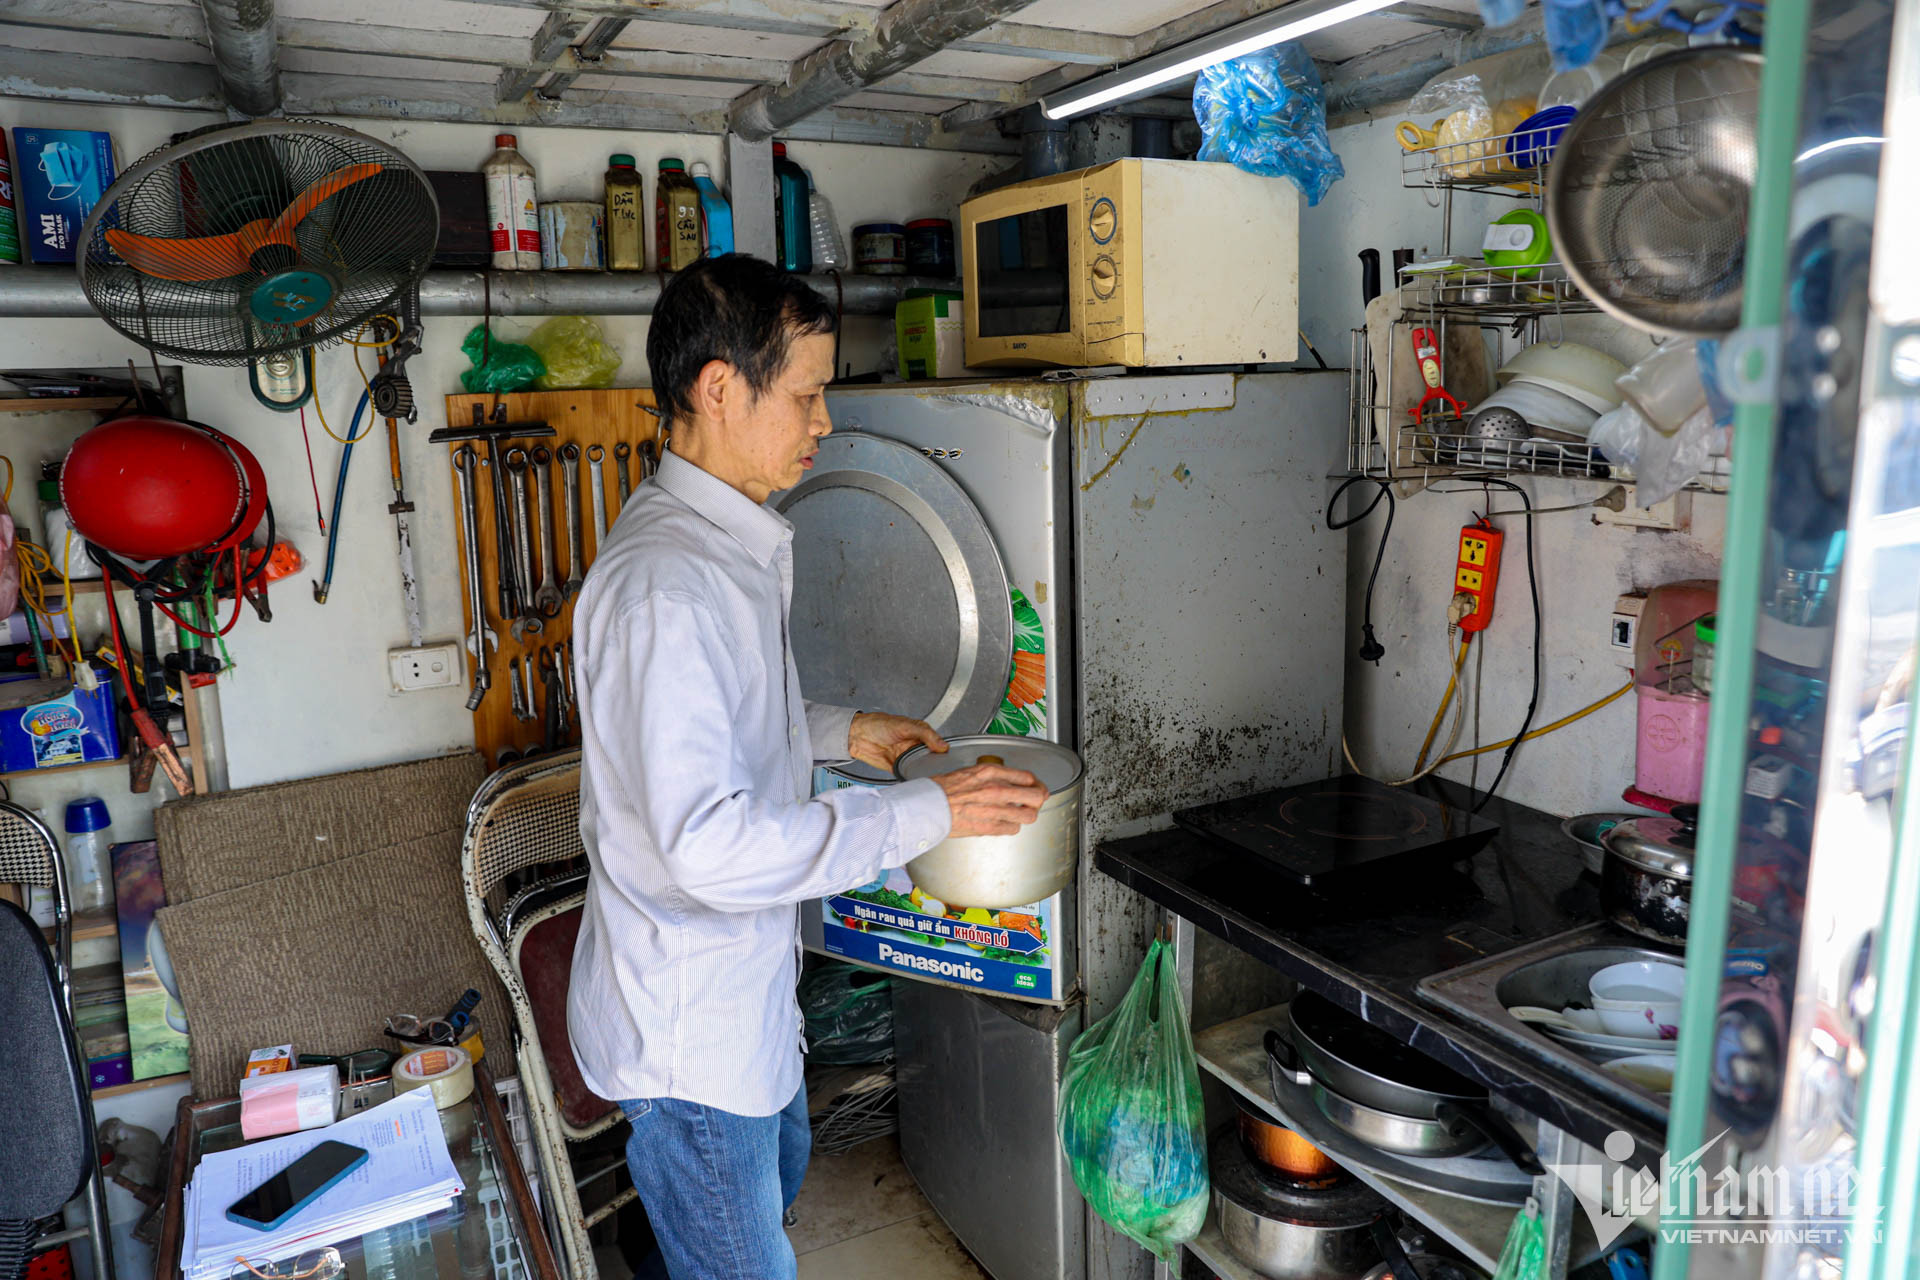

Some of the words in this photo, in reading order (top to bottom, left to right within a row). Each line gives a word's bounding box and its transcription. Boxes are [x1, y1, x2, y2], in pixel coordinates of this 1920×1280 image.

[40, 213, 58, 249] AMI
[55, 213, 64, 235] MASK
[58, 234, 66, 250] ECO
[879, 912, 896, 924] rau
[897, 915, 915, 928] quả
[917, 919, 933, 932] giữ
[935, 920, 951, 935] ẩm
[954, 924, 992, 945] KHỔNG
[878, 942, 985, 983] Panasonic
[1016, 978, 1035, 988] ideas
